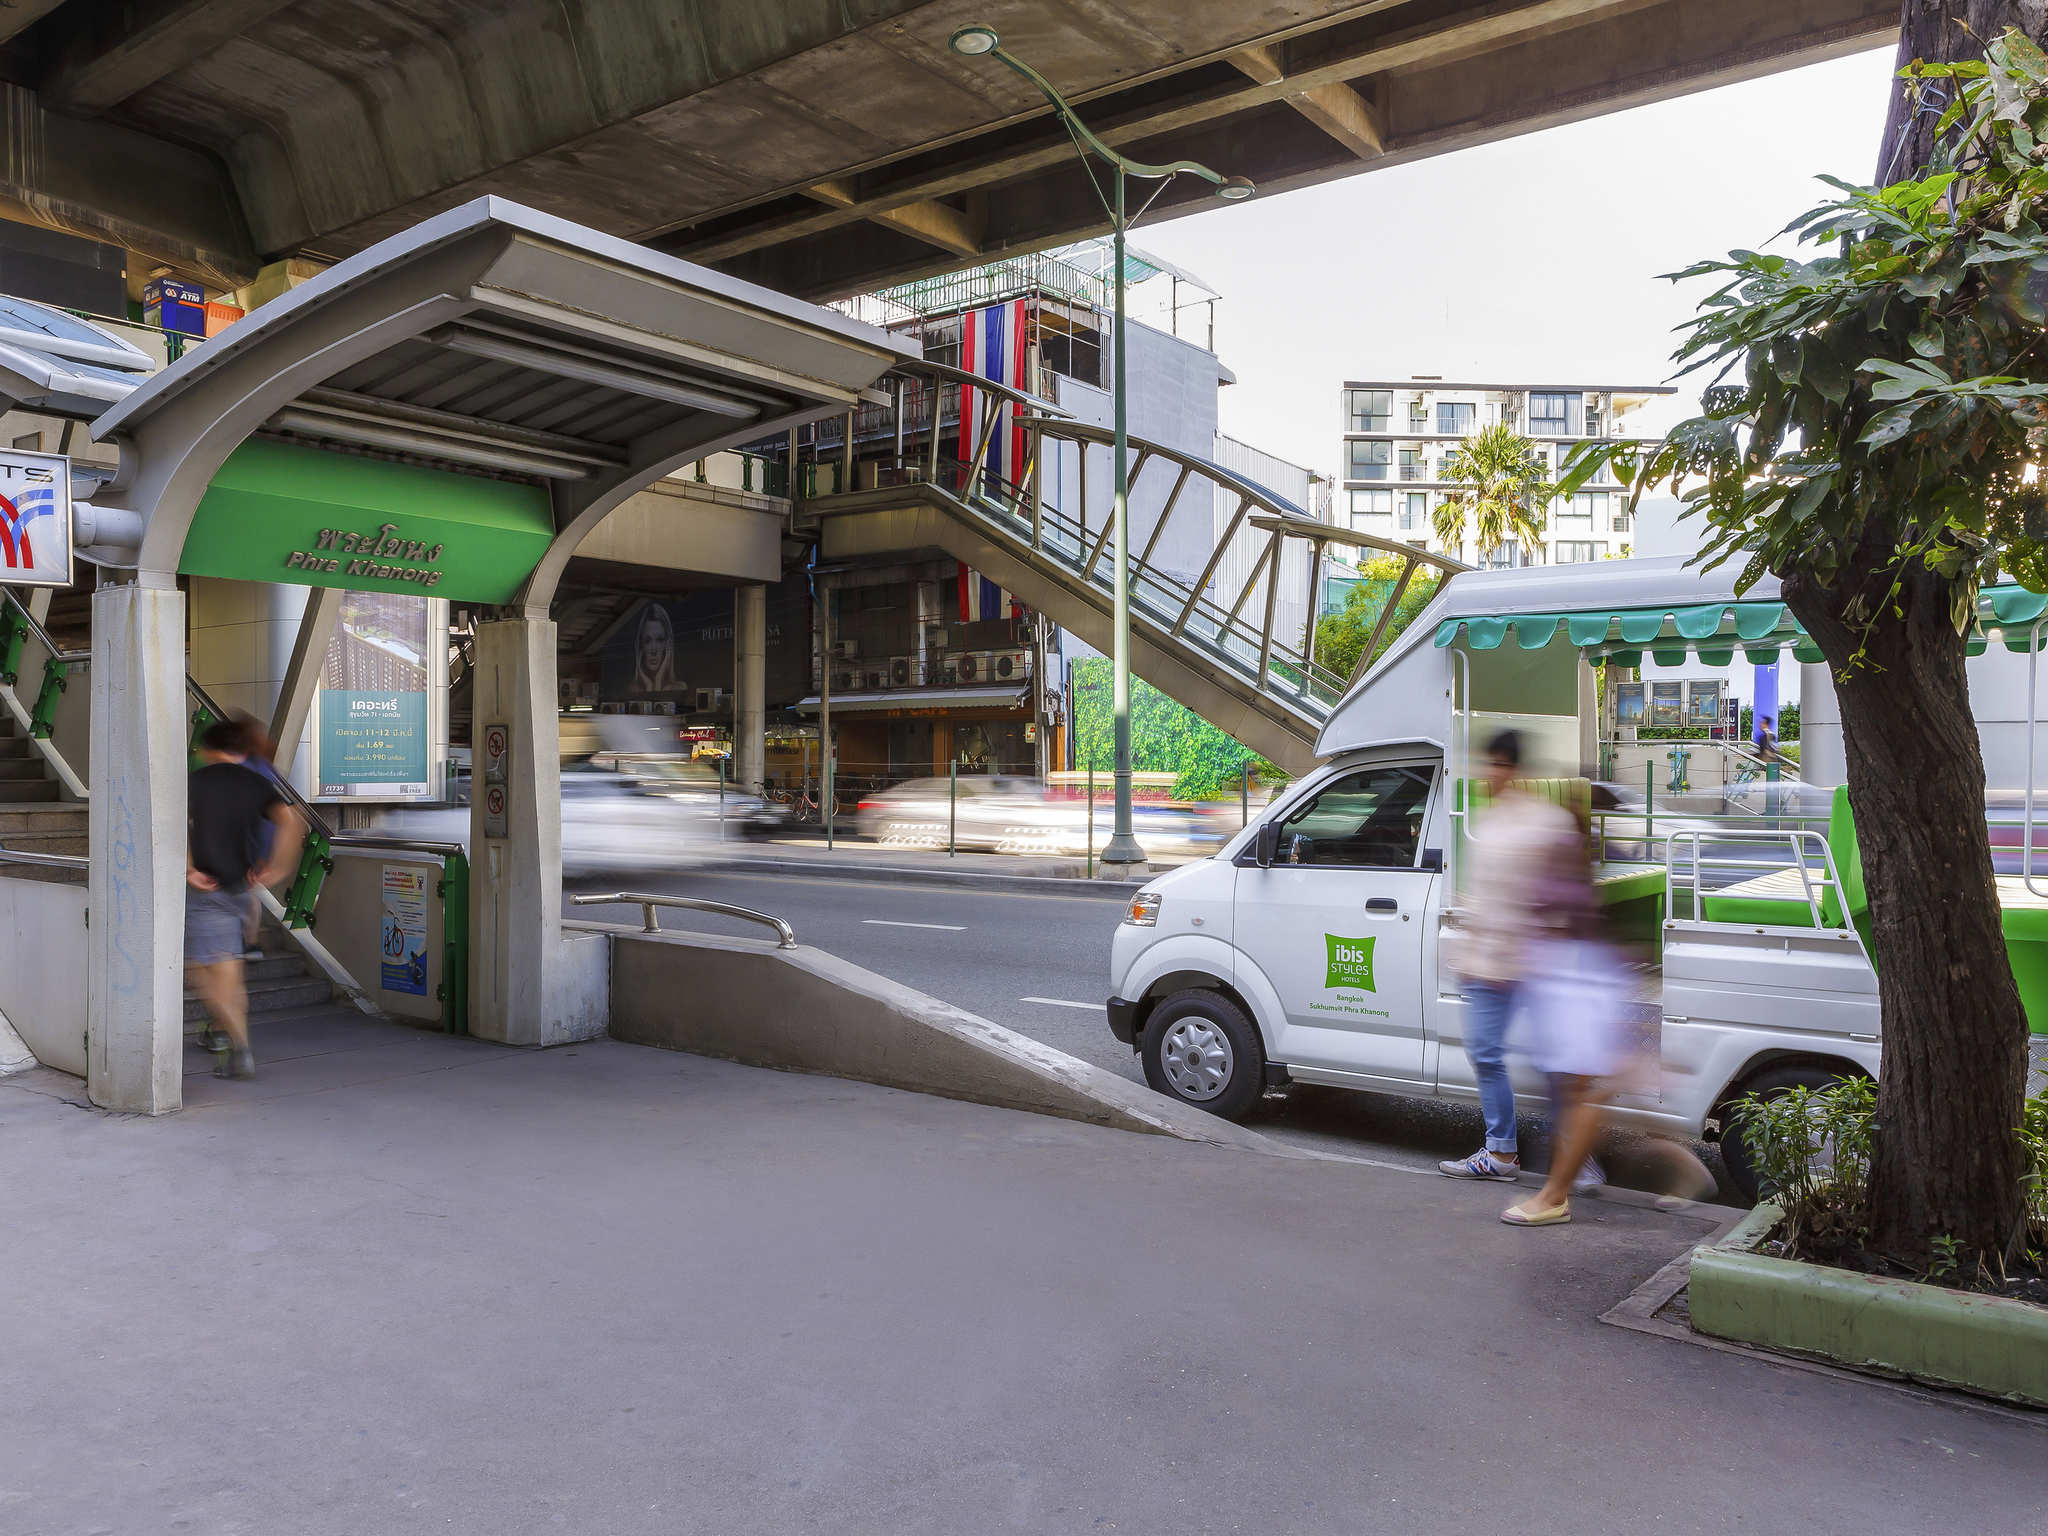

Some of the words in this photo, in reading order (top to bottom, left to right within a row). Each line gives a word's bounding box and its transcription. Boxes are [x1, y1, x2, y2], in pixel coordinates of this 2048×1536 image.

[180, 293, 200, 303] ATM
[0, 464, 54, 483] TS
[317, 523, 443, 563] พระโขนง
[286, 551, 340, 572] Phra
[346, 559, 443, 586] Khanong
[1335, 944, 1364, 963] ibis
[1336, 993, 1364, 1003] Bangkok
[1309, 1002, 1342, 1012] Sukhumvit
[1344, 1005, 1359, 1014] Phra
[1360, 1007, 1390, 1018] Khanong
